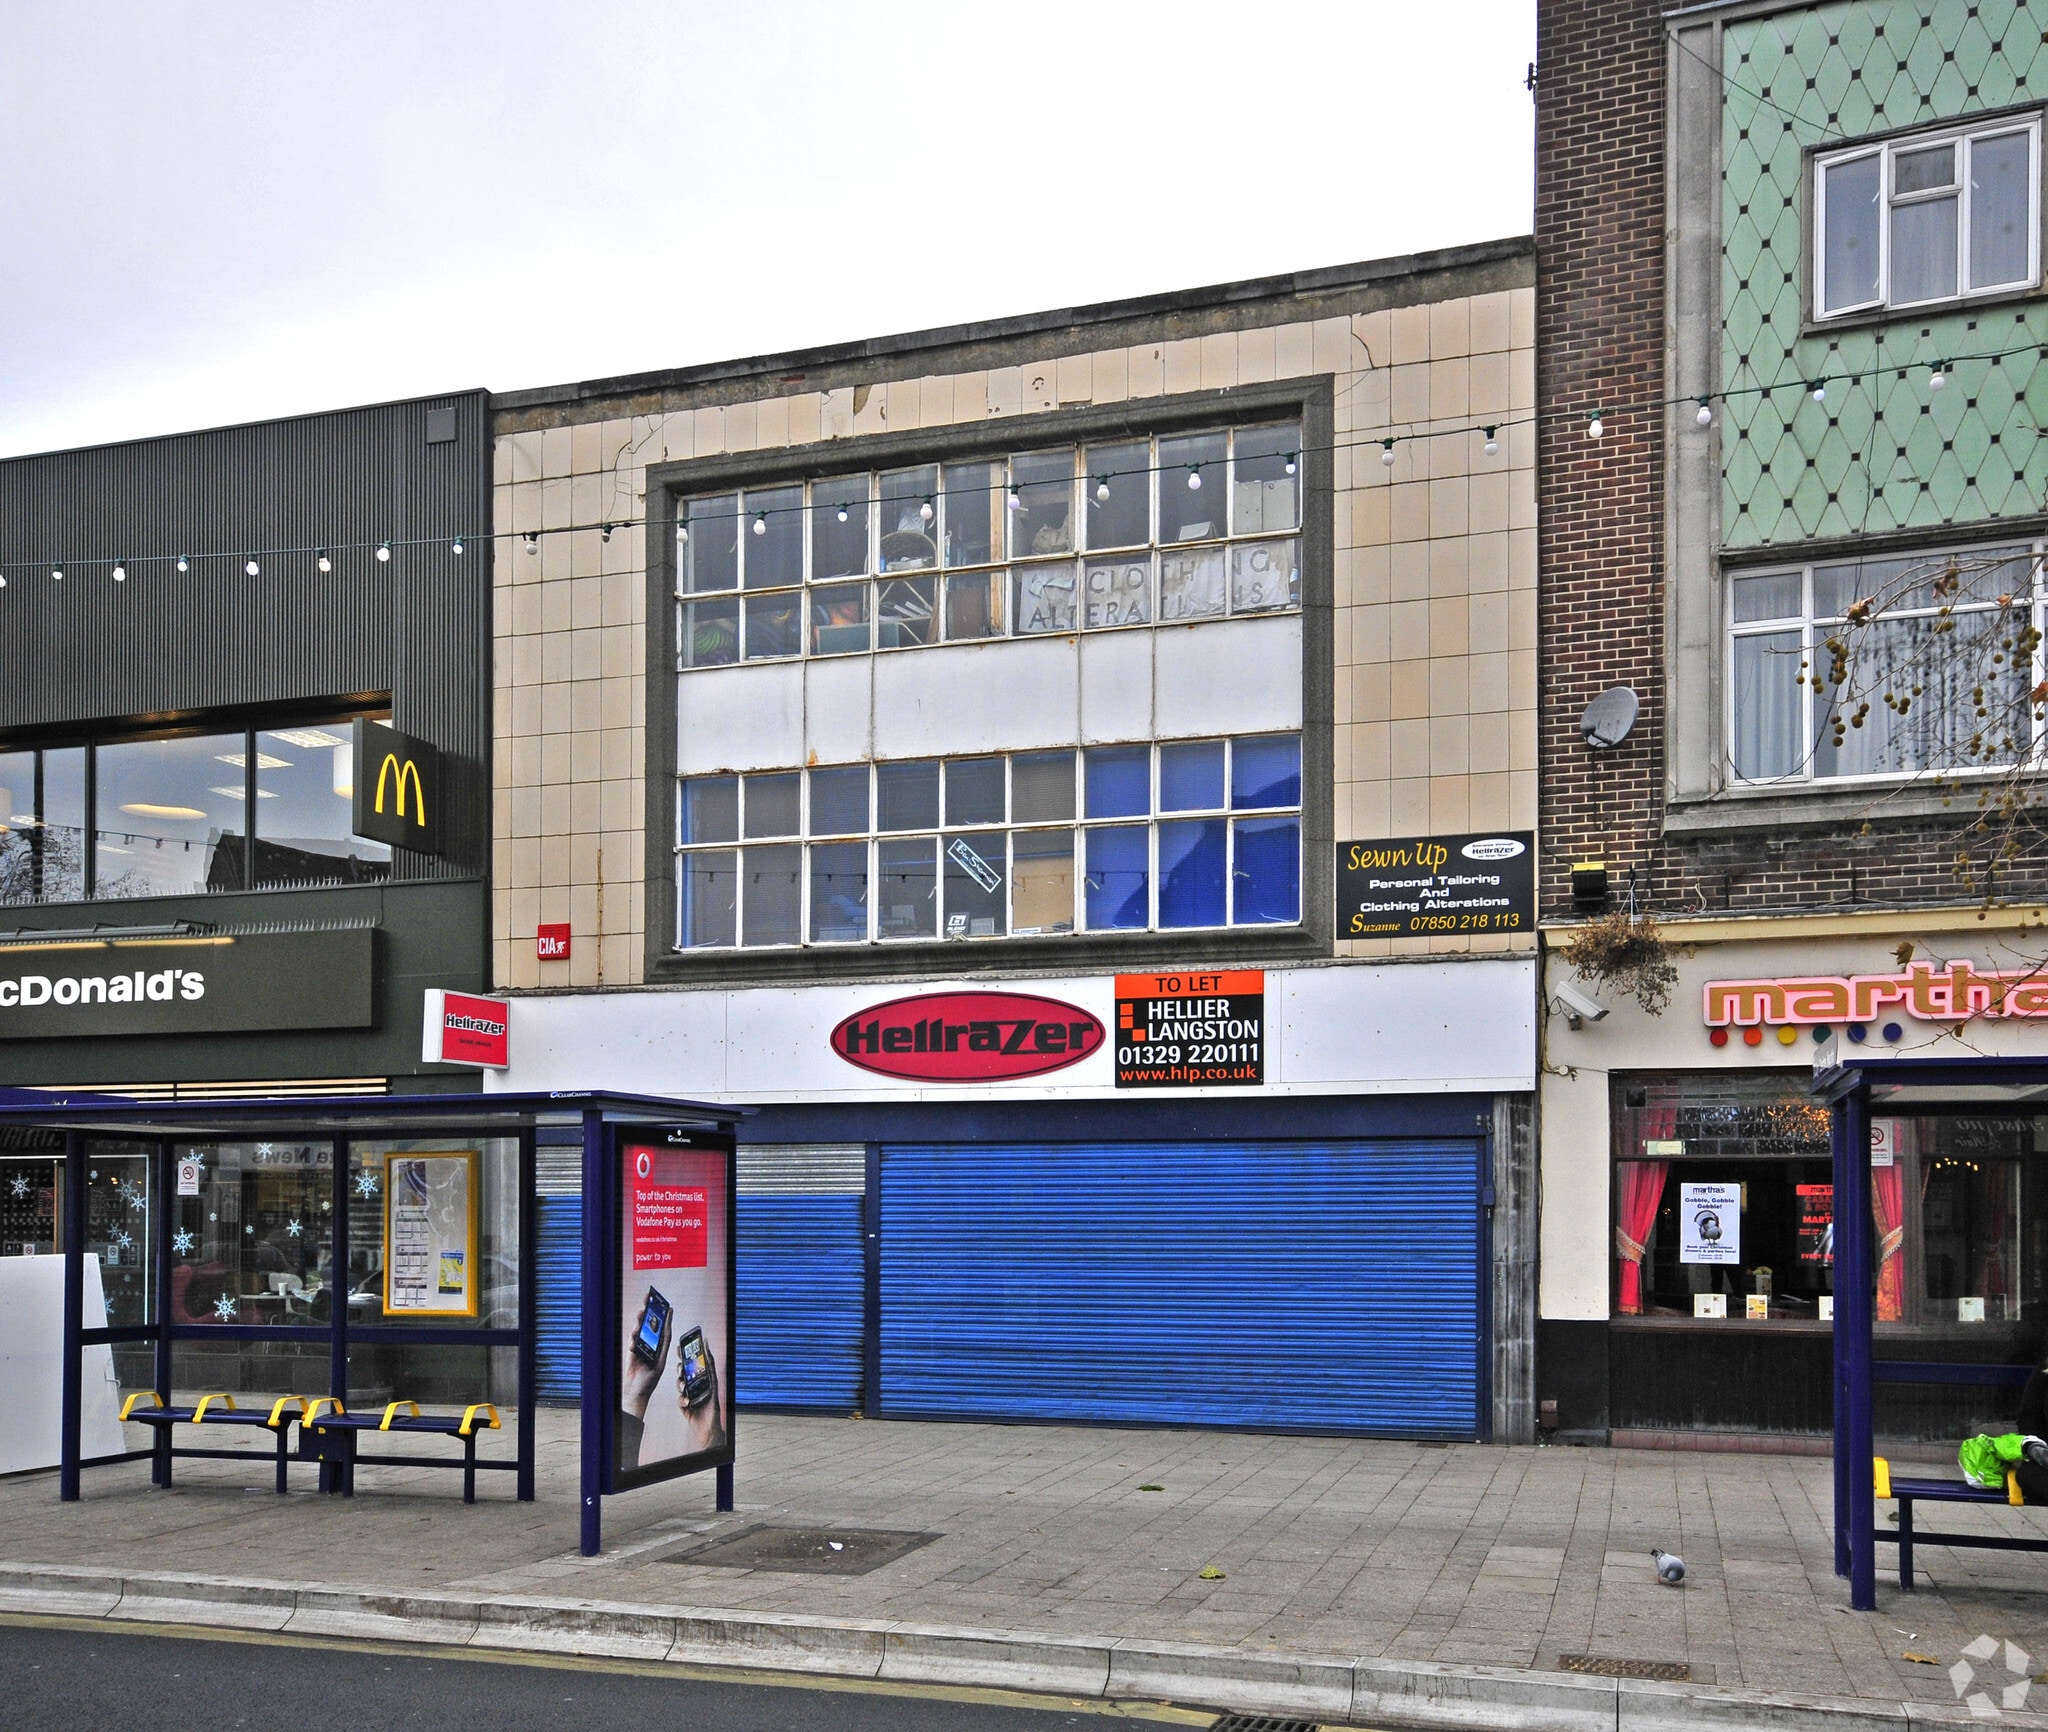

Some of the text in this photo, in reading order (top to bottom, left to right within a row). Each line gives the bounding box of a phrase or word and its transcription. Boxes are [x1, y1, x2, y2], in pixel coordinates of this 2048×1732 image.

[1088, 549, 1271, 594] CLOTHNG
[1028, 582, 1264, 629] ALTERATINS
[1347, 842, 1448, 874] Sewn Up
[1369, 874, 1500, 889] Personal Tailoring
[1419, 888, 1450, 898] And
[1360, 897, 1510, 913] Clothing Alterations
[1350, 912, 1520, 933] Suzanne 07850 218 113
[538, 937, 556, 954] CIA
[1155, 976, 1222, 994] TO LET
[1147, 998, 1230, 1020] HELLIER
[1147, 1018, 1258, 1042] LANGSTON
[1119, 1043, 1258, 1066] 01329 220111
[1120, 1063, 1257, 1082] www.hlp.co.uk
[636, 1190, 704, 1202] Top of the Christmas list.
[636, 1204, 683, 1215] Smartphones on
[636, 1217, 663, 1227] Vodafone
[664, 1217, 674, 1229] Pay
[682, 1219, 693, 1228] you
[693, 1219, 702, 1229] go.
[1802, 1215, 1833, 1223] MART
[636, 1253, 672, 1265] power to you
